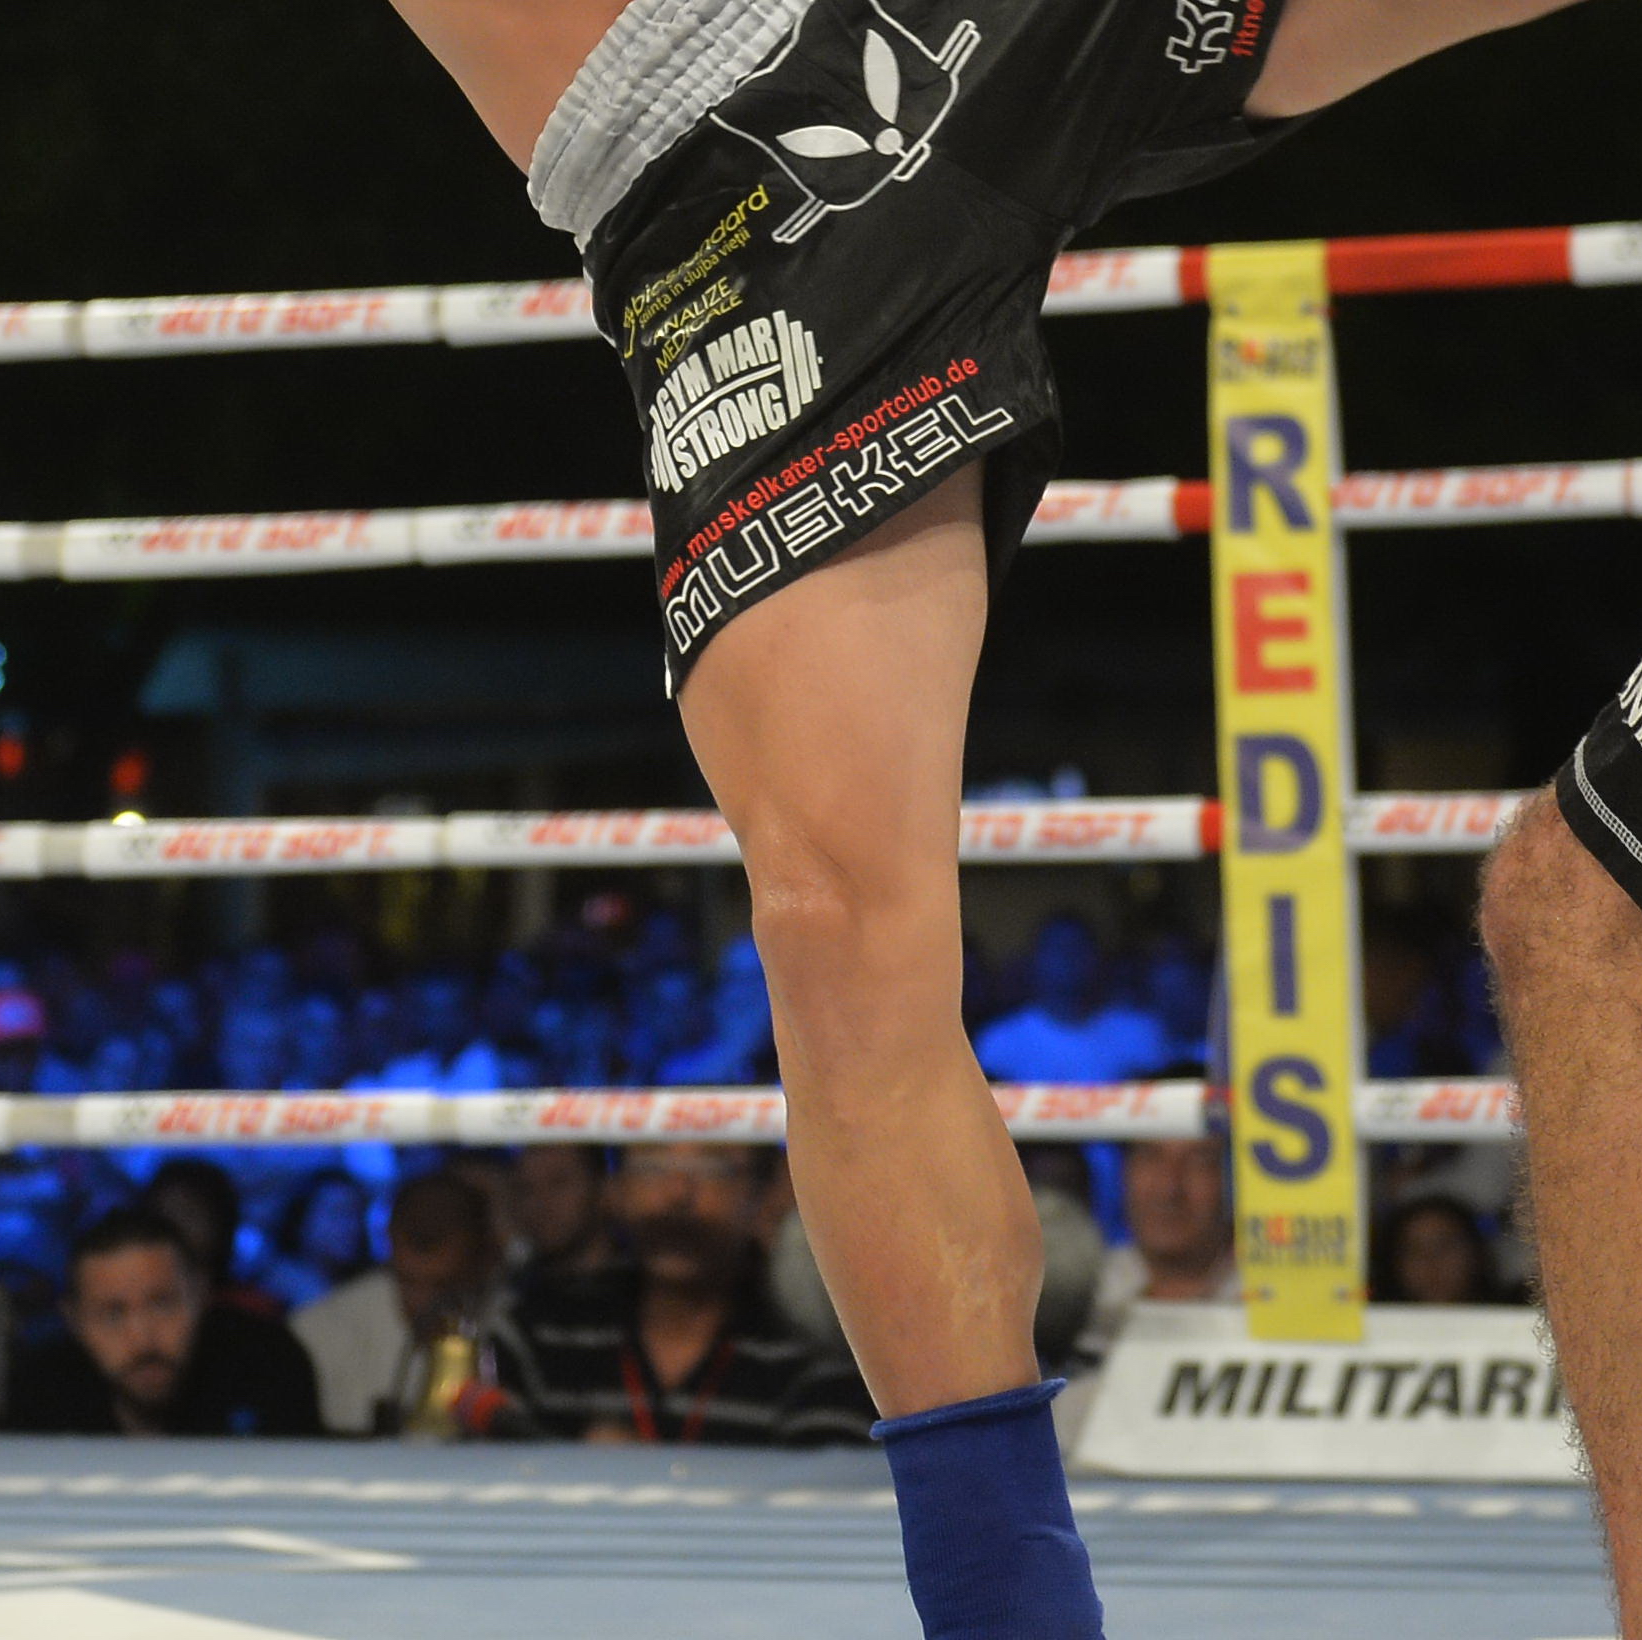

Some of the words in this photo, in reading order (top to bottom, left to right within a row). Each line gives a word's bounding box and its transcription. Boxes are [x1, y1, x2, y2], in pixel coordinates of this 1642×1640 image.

[157, 295, 267, 336] AUTO
[652, 275, 734, 346] ANALIZE
[655, 290, 744, 376] MEDICALE
[655, 352, 712, 431] GYM
[705, 316, 780, 384] MAR
[671, 382, 788, 480] STRONG
[661, 356, 980, 599] www.muskelkater-sportclub.de
[140, 515, 250, 554] AUTO
[494, 502, 603, 541] AUTO
[665, 394, 1015, 655] MUSKEL
[1226, 414, 1333, 1181] REDIS
[1373, 795, 1502, 836] AUTO
[159, 823, 276, 861] AUTO
[526, 812, 646, 847] AUTO
[154, 1097, 272, 1135] AUTO
[536, 1092, 655, 1131] AUTO
